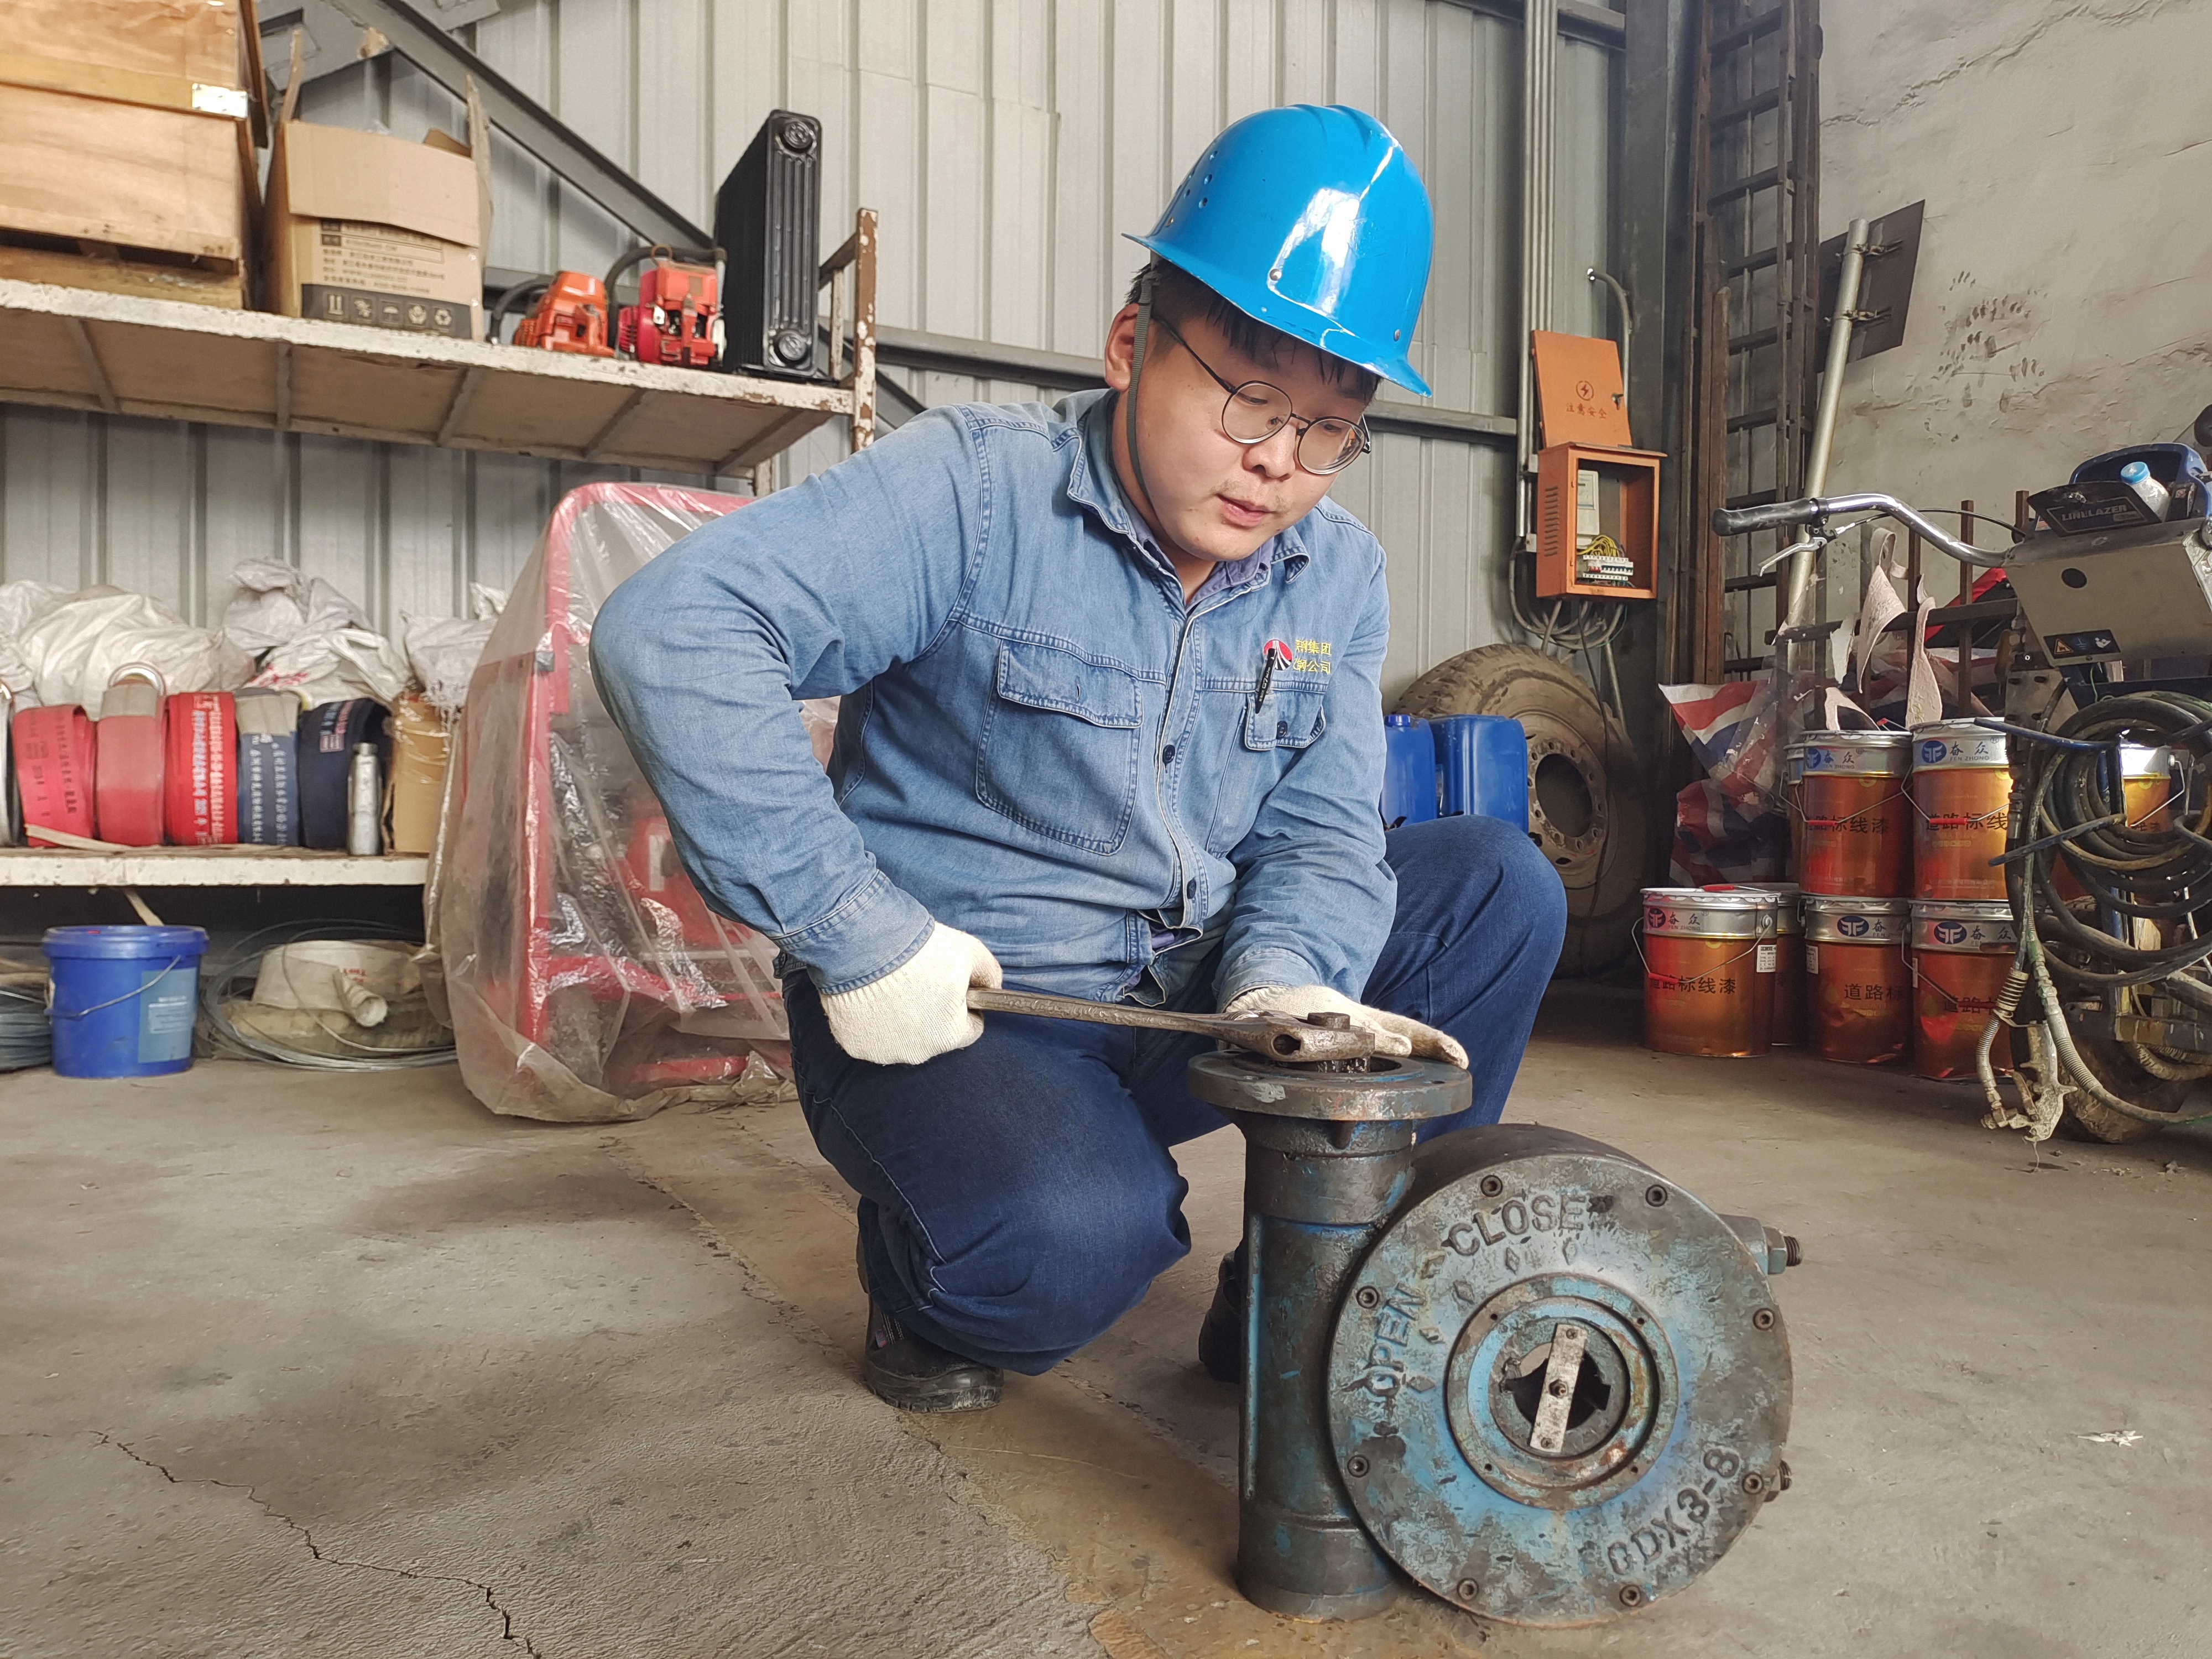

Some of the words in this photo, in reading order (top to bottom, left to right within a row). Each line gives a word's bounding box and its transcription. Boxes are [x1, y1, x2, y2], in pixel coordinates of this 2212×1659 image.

[1566, 402, 1607, 419] 注意安全
[1448, 1194, 1586, 1256] CLOSE
[1365, 1282, 1427, 1396] OPEN
